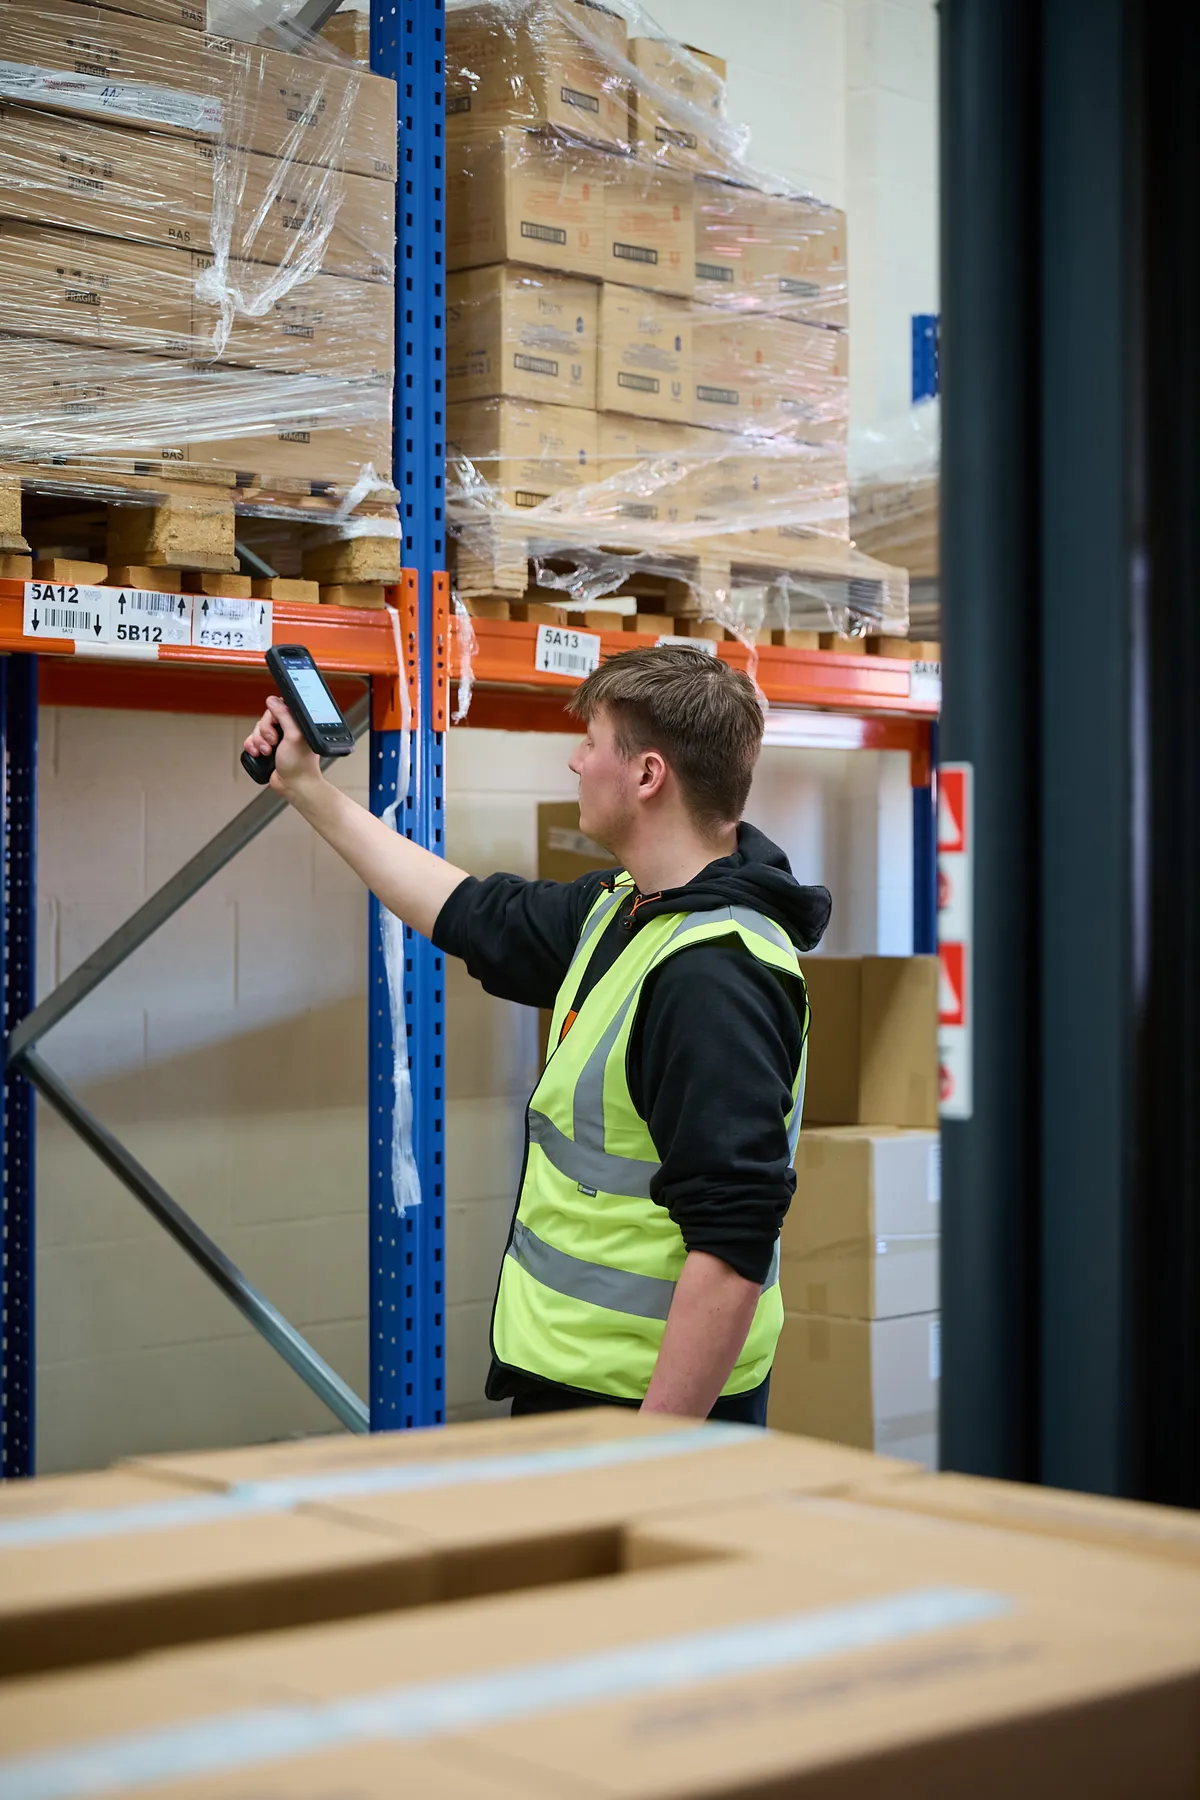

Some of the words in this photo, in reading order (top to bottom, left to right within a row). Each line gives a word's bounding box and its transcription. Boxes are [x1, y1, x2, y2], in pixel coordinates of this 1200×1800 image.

[168, 228, 191, 241] BAS
[65, 289, 100, 306] FRAGILE
[279, 429, 310, 443] FRAGILE
[162, 449, 184, 460] BAS
[31, 583, 79, 604] 5A12
[117, 624, 162, 643] 5B12
[200, 629, 243, 648] 5C12
[545, 629, 579, 649] 5A13
